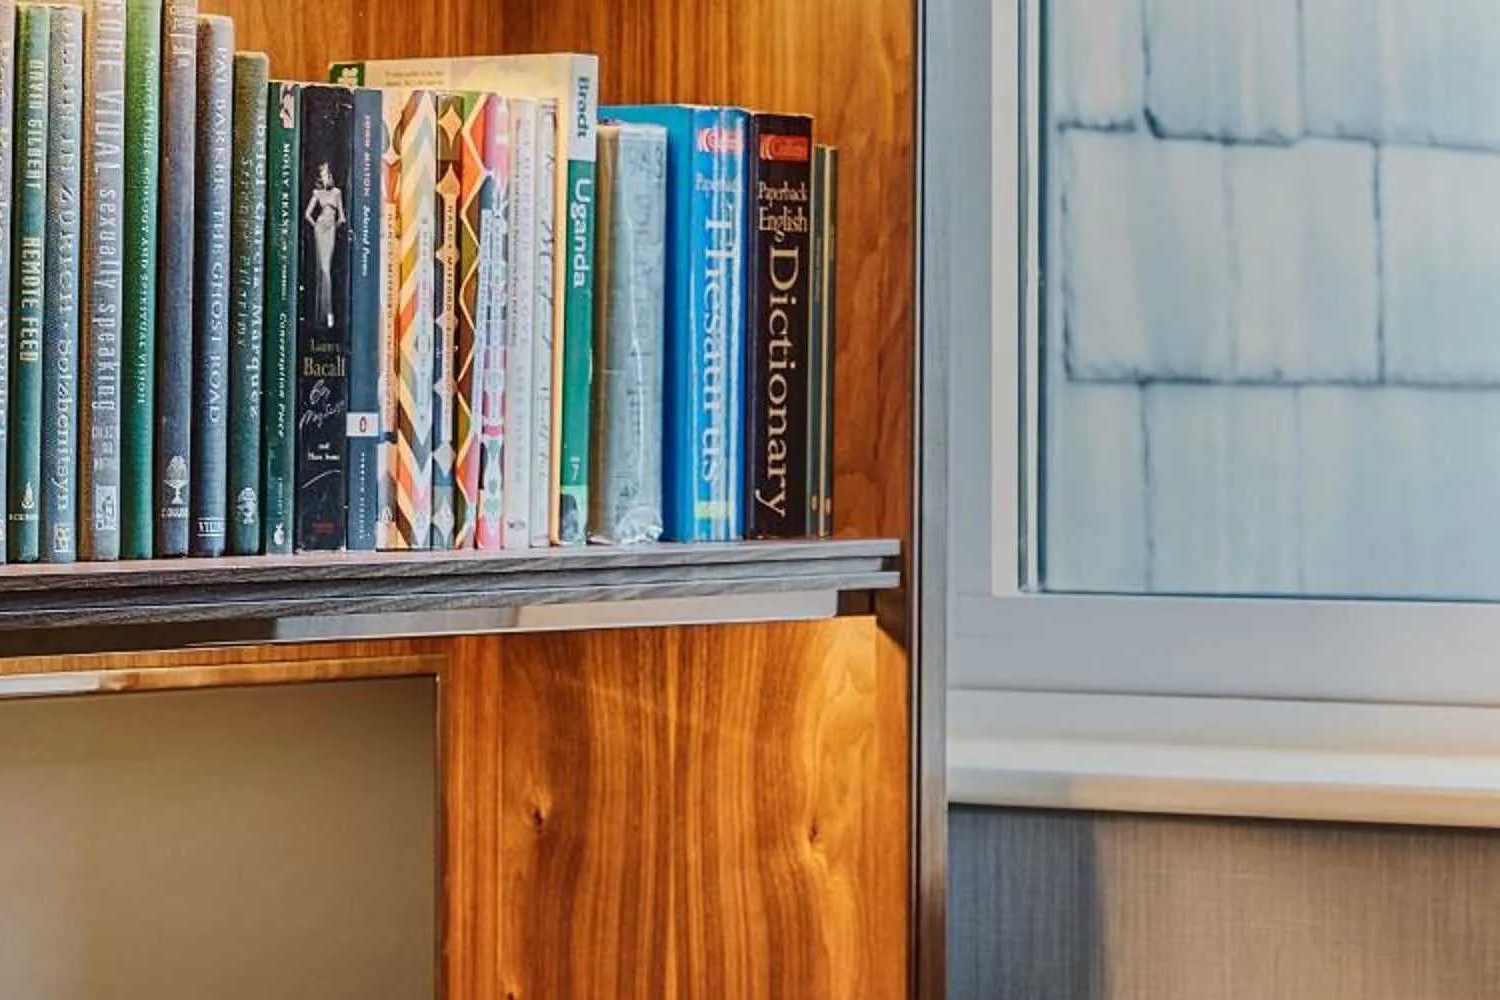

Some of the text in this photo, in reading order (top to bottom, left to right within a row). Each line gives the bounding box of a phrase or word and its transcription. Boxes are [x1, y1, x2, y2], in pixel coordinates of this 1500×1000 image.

[26, 59, 46, 191] DAVID GILBERT
[94, 88, 121, 176] VIDAL
[212, 98, 227, 193] BARKER
[577, 76, 590, 138] Bradt
[281, 143, 291, 187] MOLLY
[362, 152, 372, 197] MILTON
[758, 180, 807, 206] Paperback
[58, 184, 74, 313] ZURICH
[93, 188, 120, 290] sexually
[211, 207, 226, 256] THE
[571, 177, 592, 289] Uganda
[758, 206, 807, 242] English
[19, 237, 41, 362] REMOTE FEED
[210, 261, 223, 343] GHOST
[91, 302, 118, 411] speaking
[136, 352, 148, 404] VISION
[303, 355, 346, 377] Bacall
[702, 203, 740, 483] Thesaurus
[755, 246, 799, 518] Dictionary
[51, 338, 73, 511] Solzhenitsyn
[208, 353, 222, 424] ROAD
[277, 403, 287, 438] Piece
